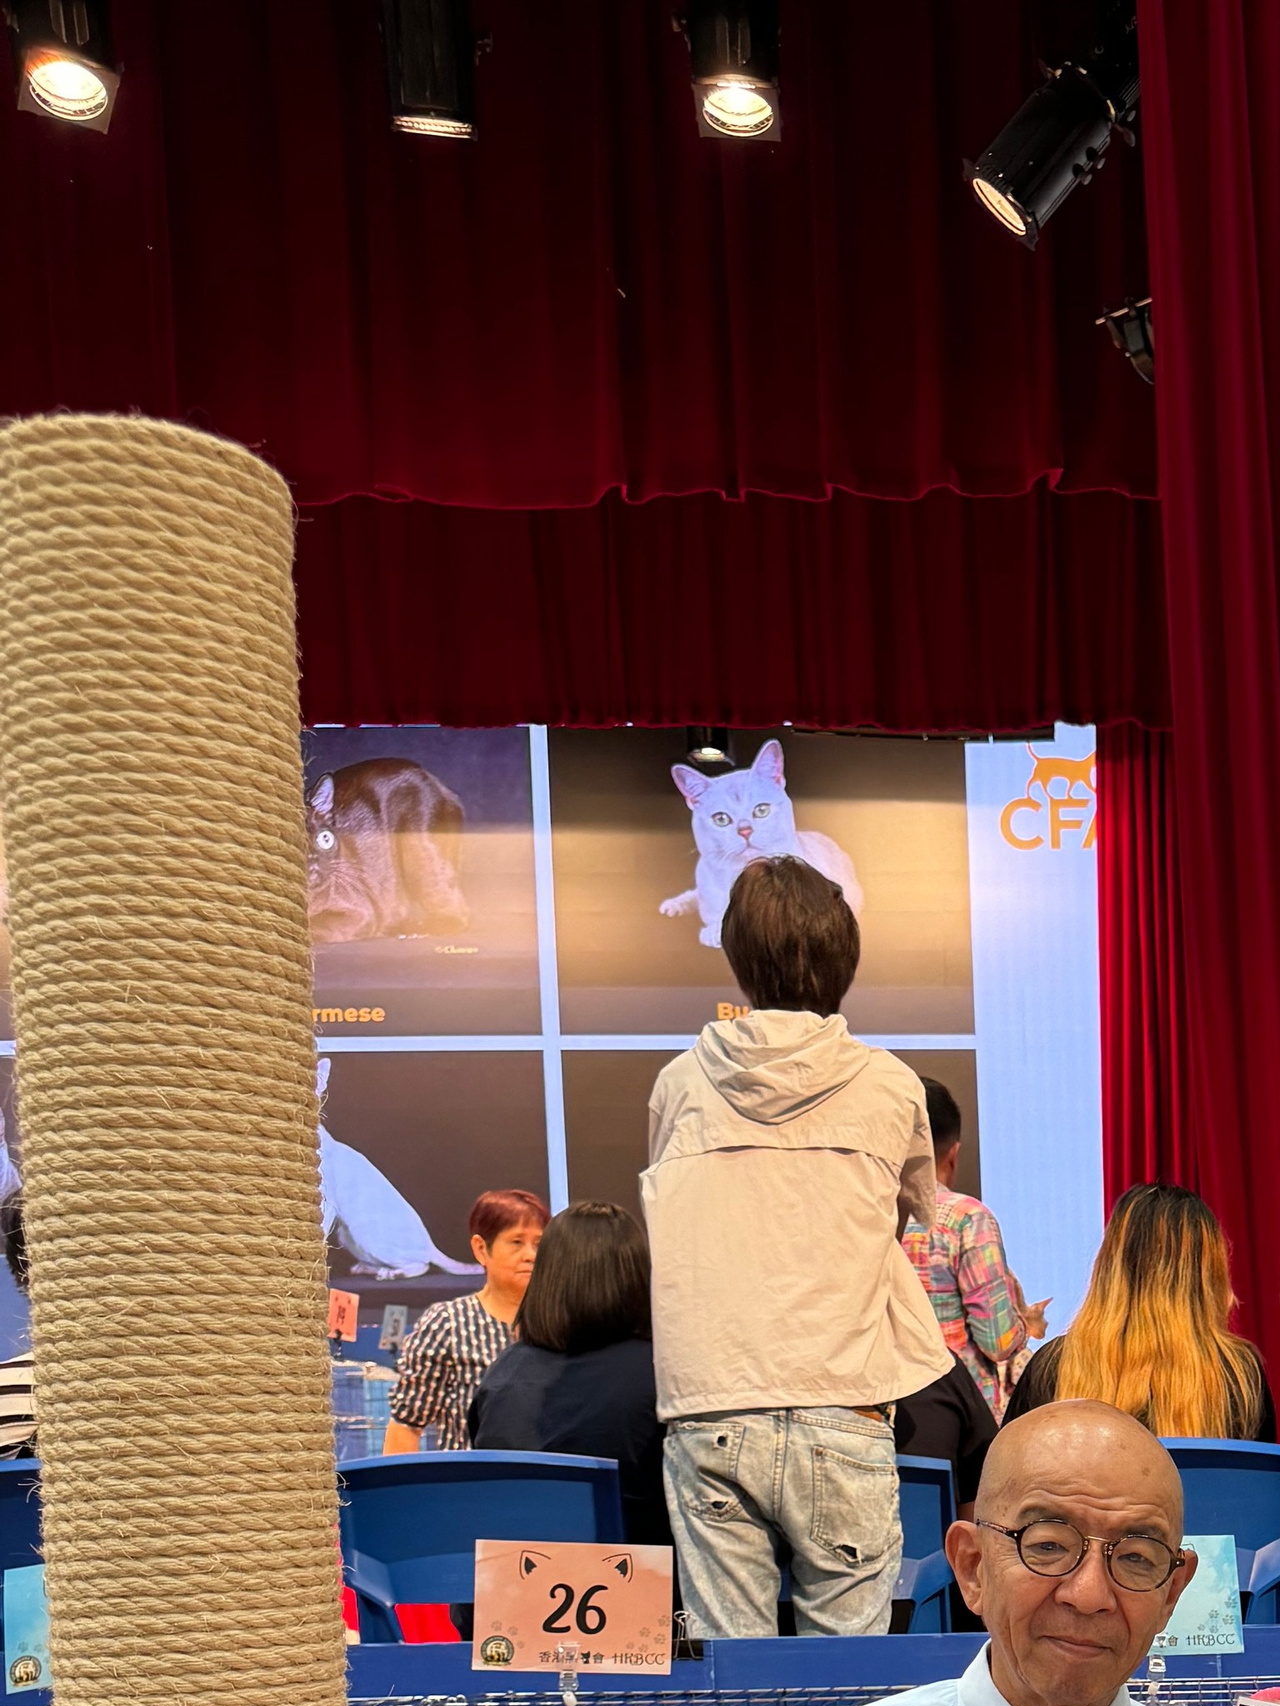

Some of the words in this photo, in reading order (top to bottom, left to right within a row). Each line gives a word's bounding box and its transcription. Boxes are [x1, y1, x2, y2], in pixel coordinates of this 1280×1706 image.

[1000, 798, 1096, 850] CF
[312, 1007, 385, 1023] rmese
[542, 1583, 608, 1635] 26
